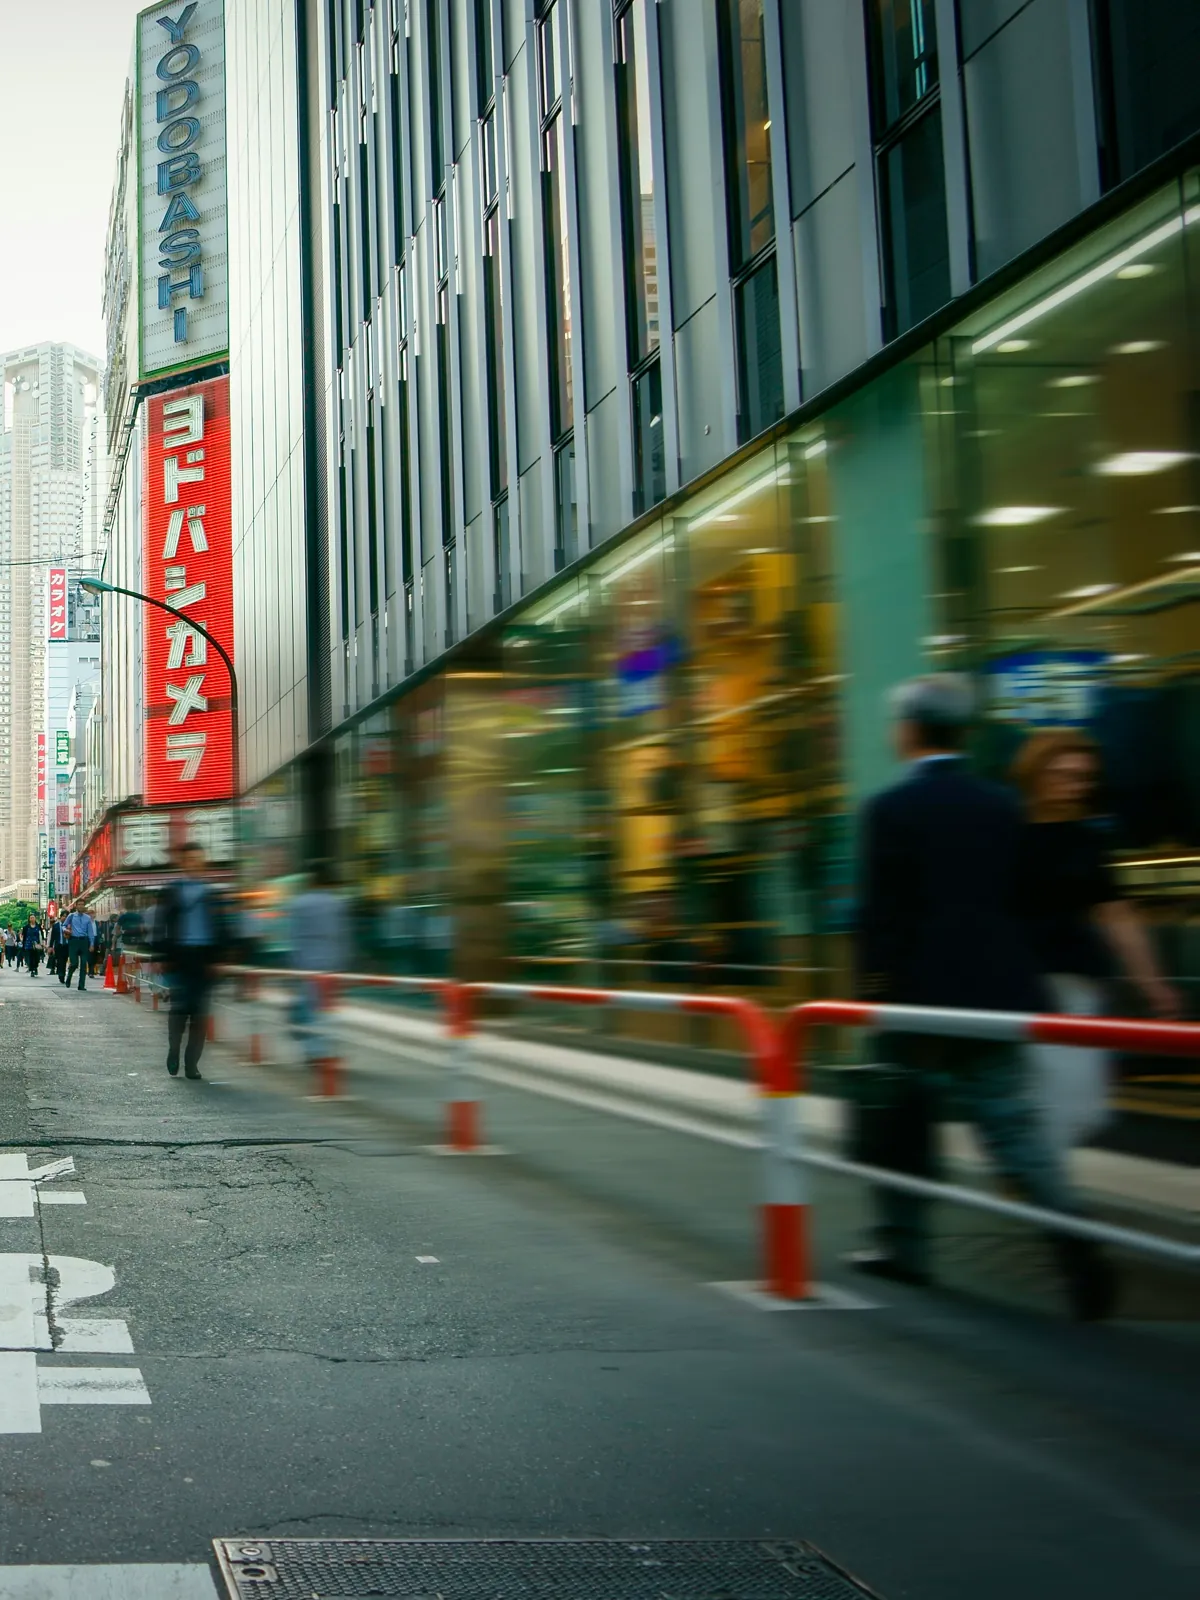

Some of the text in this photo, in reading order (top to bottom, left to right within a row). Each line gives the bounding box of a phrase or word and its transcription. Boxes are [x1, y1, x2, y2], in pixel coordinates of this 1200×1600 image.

[156, 1, 204, 343] YODOBASHI
[50, 573, 65, 633] カラオケ
[162, 393, 209, 781] ヨドバシカメラ
